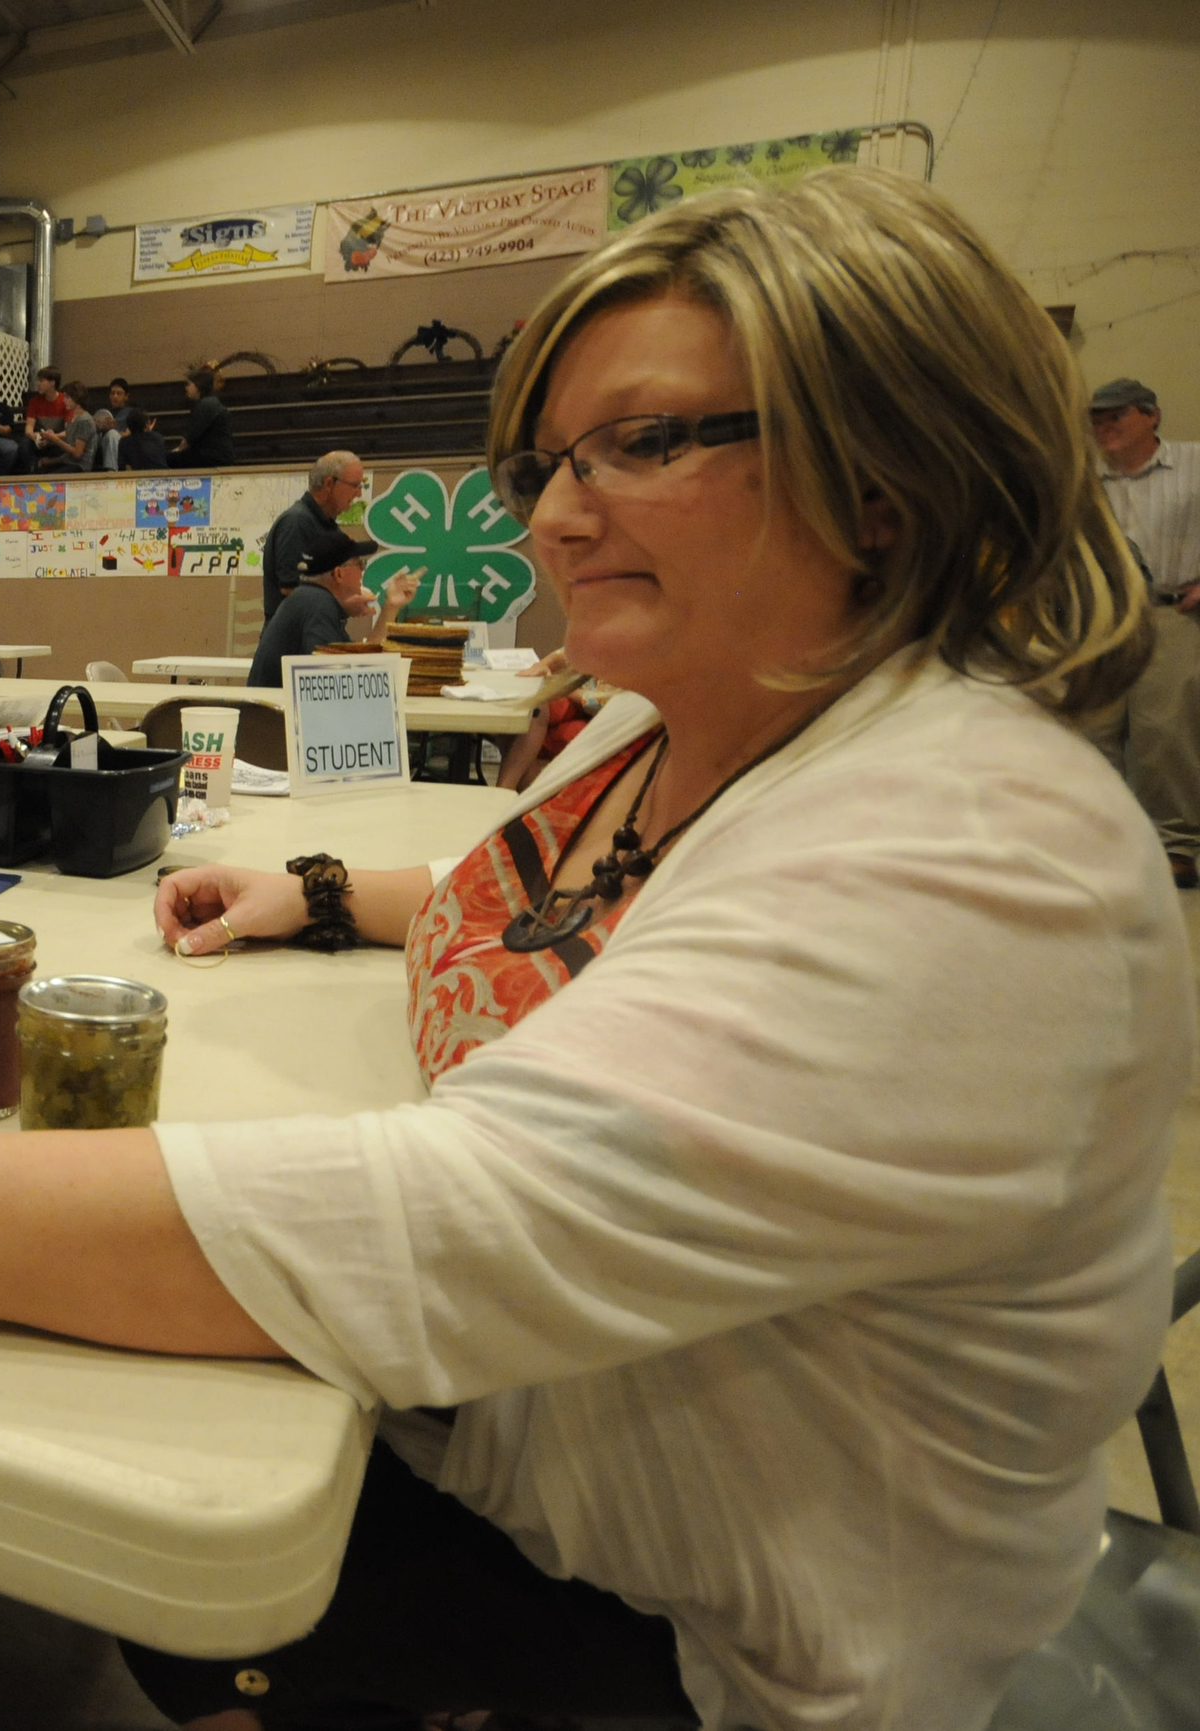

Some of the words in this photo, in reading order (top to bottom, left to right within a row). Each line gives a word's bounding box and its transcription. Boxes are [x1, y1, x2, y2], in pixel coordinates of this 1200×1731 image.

[390, 203, 434, 223] THE
[435, 193, 526, 219] VICTORY
[530, 177, 597, 204] STAGE
[186, 220, 267, 248] Signs
[466, 238, 535, 259] 949-9904
[390, 493, 432, 534] H
[466, 490, 507, 533] H
[31, 532, 44, 541] I
[118, 530, 136, 542] 4-H
[141, 529, 155, 541] IS
[178, 532, 192, 541] 4-H
[29, 544, 53, 554] JUST
[131, 541, 167, 557] BLAST
[35, 567, 88, 579] CHOCOLATE!
[300, 674, 354, 701] PRESERVED
[358, 672, 390, 699] FOODS
[306, 741, 395, 773] STUDENT
